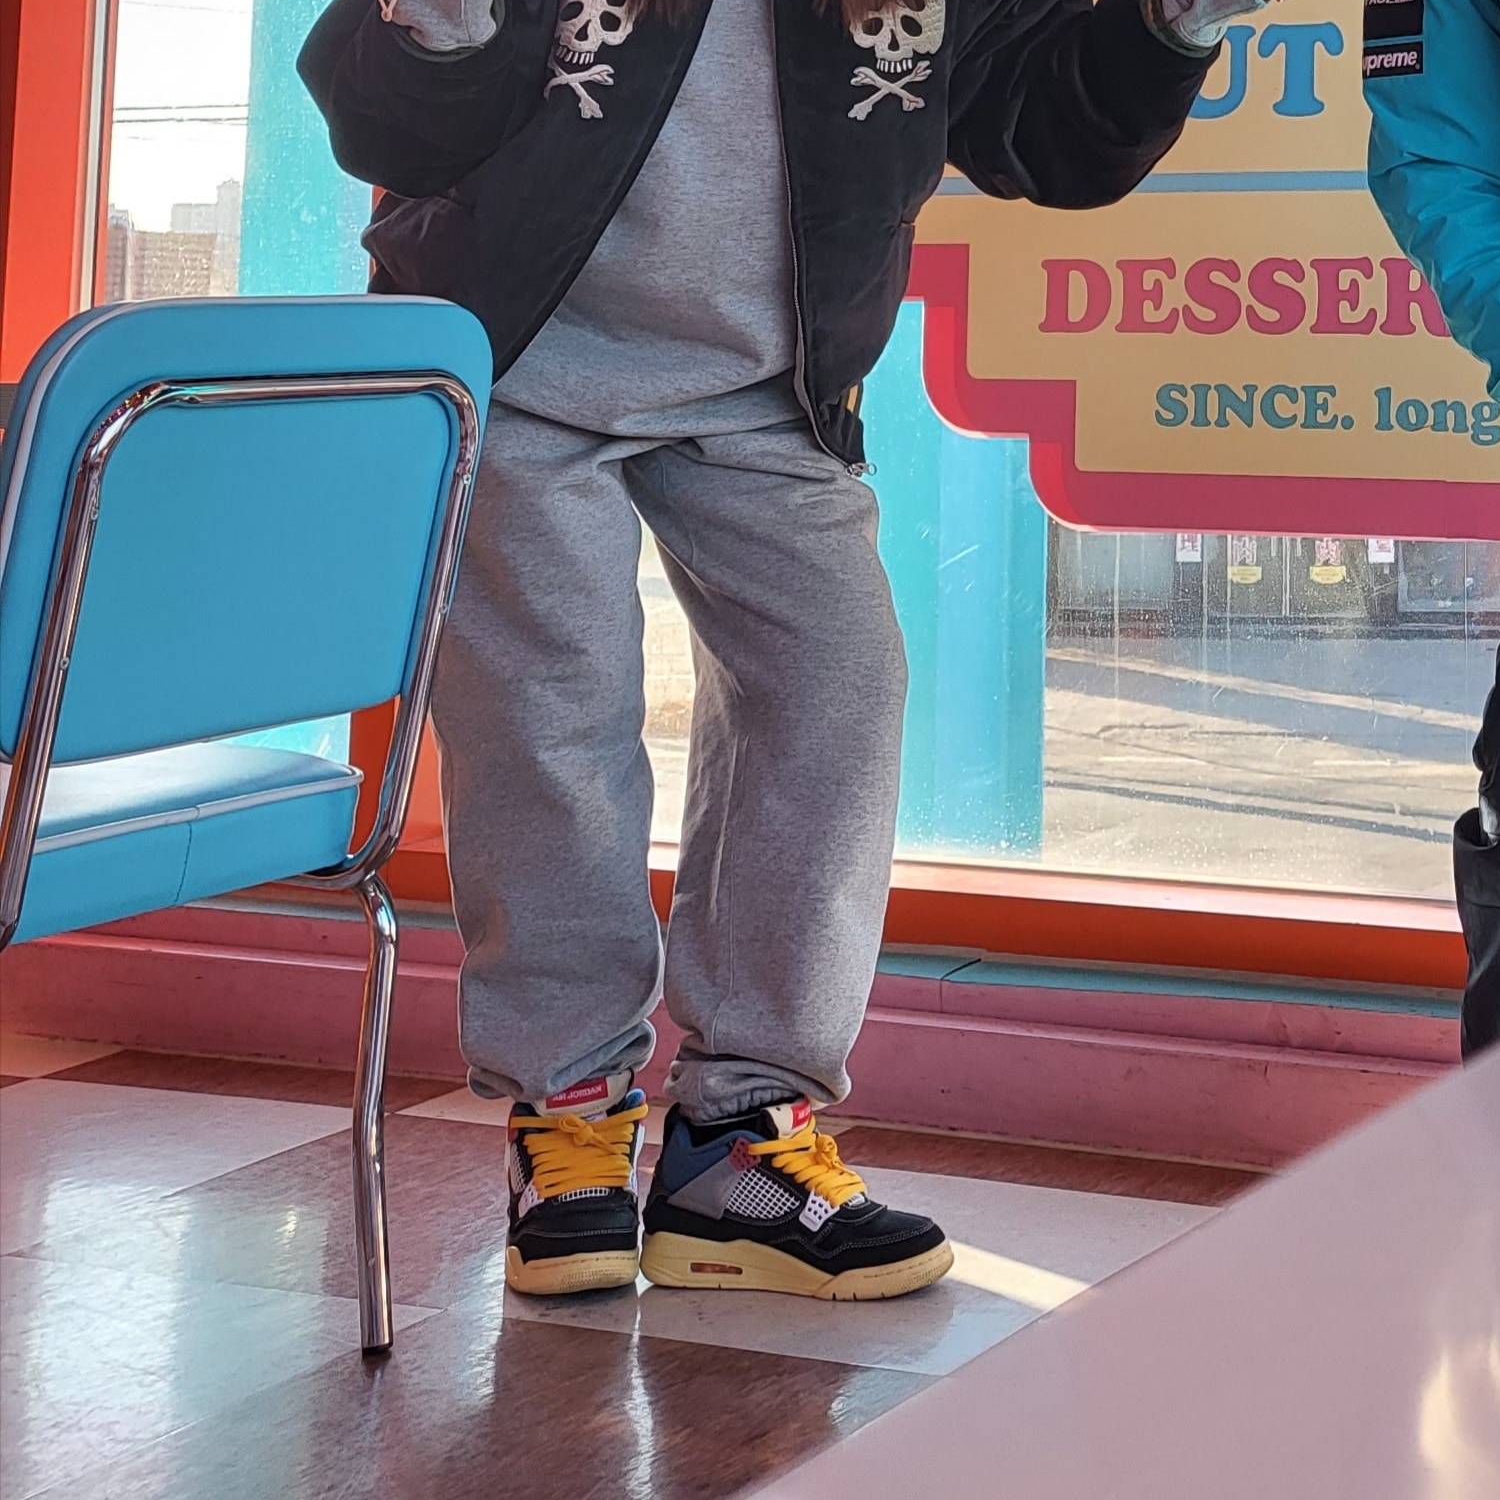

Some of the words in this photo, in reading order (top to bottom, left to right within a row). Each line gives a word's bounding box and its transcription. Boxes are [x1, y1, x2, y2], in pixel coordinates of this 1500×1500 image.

[1363, 50, 1418, 77] upreme
[1037, 256, 1452, 338] DESSER
[1155, 383, 1356, 430] SINCE.
